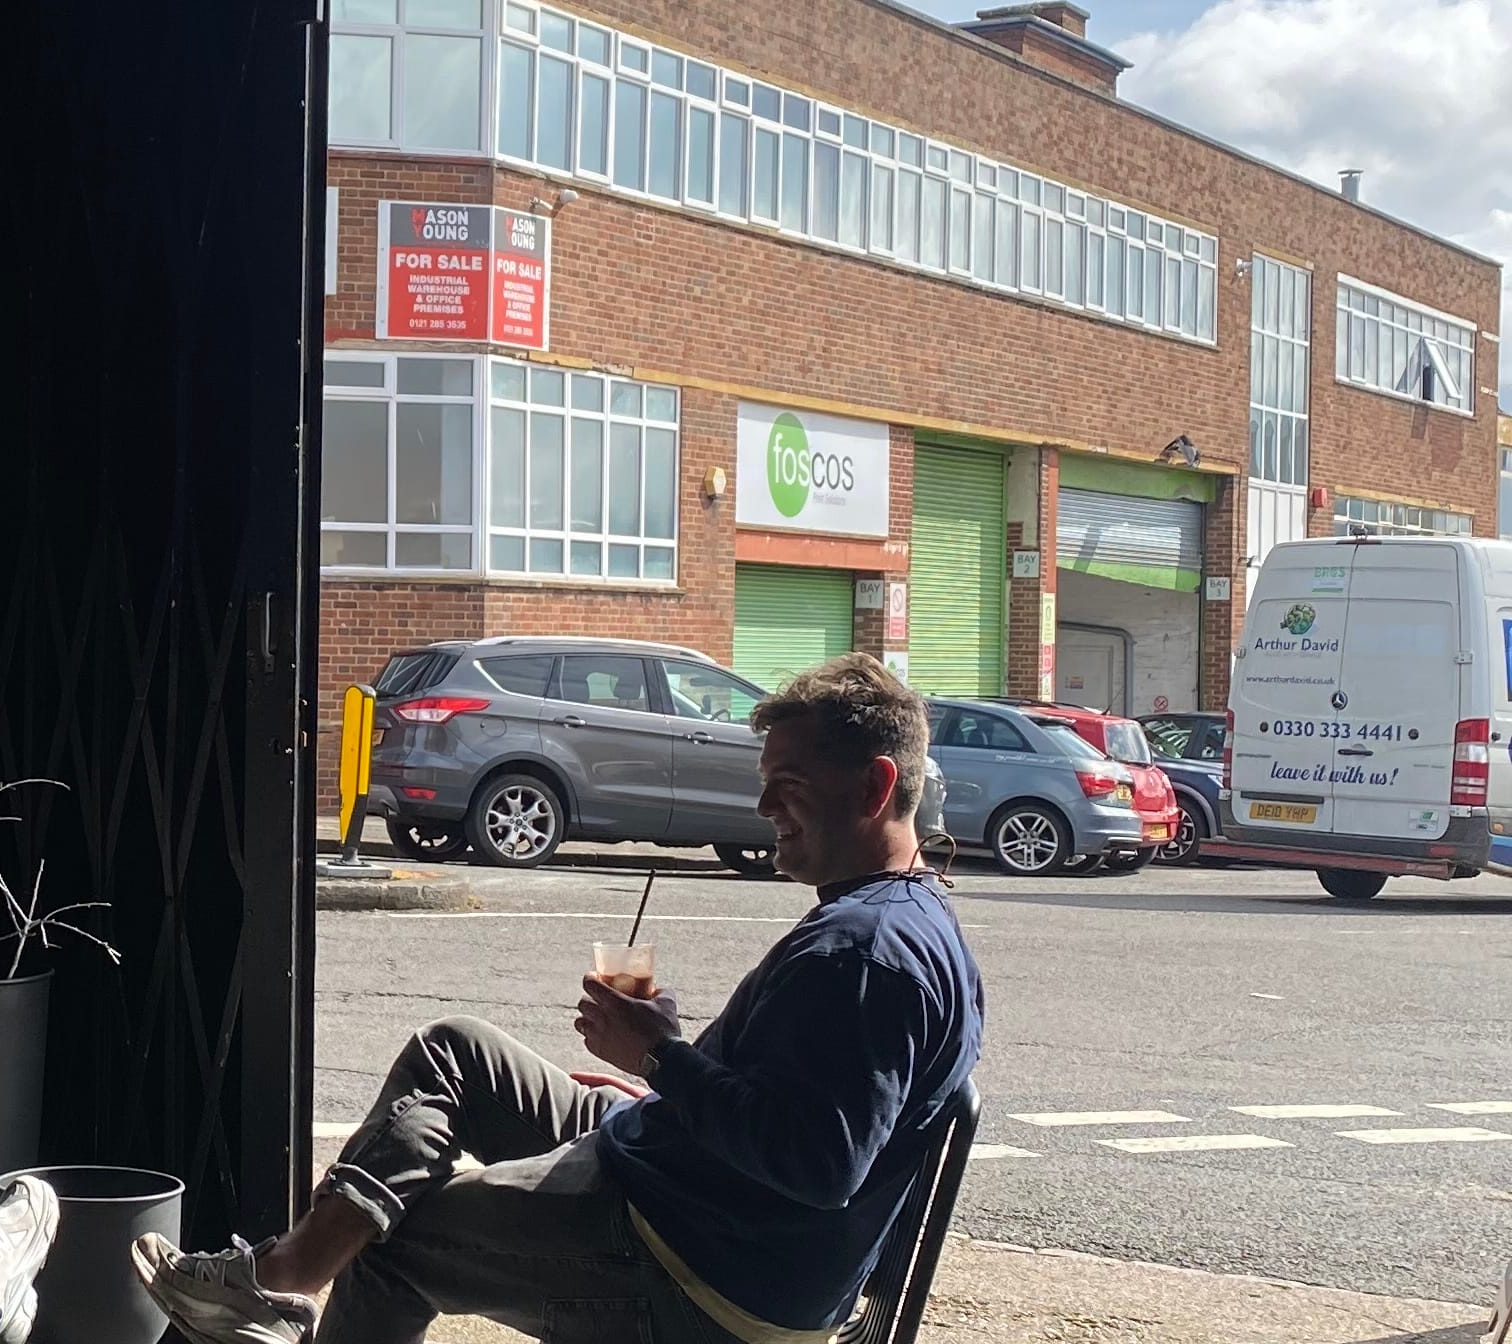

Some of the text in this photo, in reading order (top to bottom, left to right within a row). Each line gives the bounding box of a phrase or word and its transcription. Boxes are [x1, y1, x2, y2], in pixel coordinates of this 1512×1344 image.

[412, 209, 468, 225] MASON
[413, 223, 468, 240] YOUNG
[395, 253, 483, 271] FOR SALE
[497, 258, 541, 280] FOR SALE
[409, 274, 468, 285] INDUSTRIAL
[407, 284, 470, 295] WAREHOUSE
[425, 294, 462, 305] OFFICE
[413, 303, 464, 314] PREMISES
[409, 318, 427, 328] 0121
[773, 432, 854, 492] foscos
[1017, 554, 1036, 564] BAY
[1023, 564, 1030, 574] 2
[860, 583, 880, 593] BAY
[1210, 579, 1227, 587] BAY
[1254, 637, 1339, 652] Arthur David
[1273, 720, 1401, 741] 0330 333 4441
[1271, 761, 1310, 779] leave
[1313, 764, 1326, 782] it
[1328, 765, 1366, 784] with
